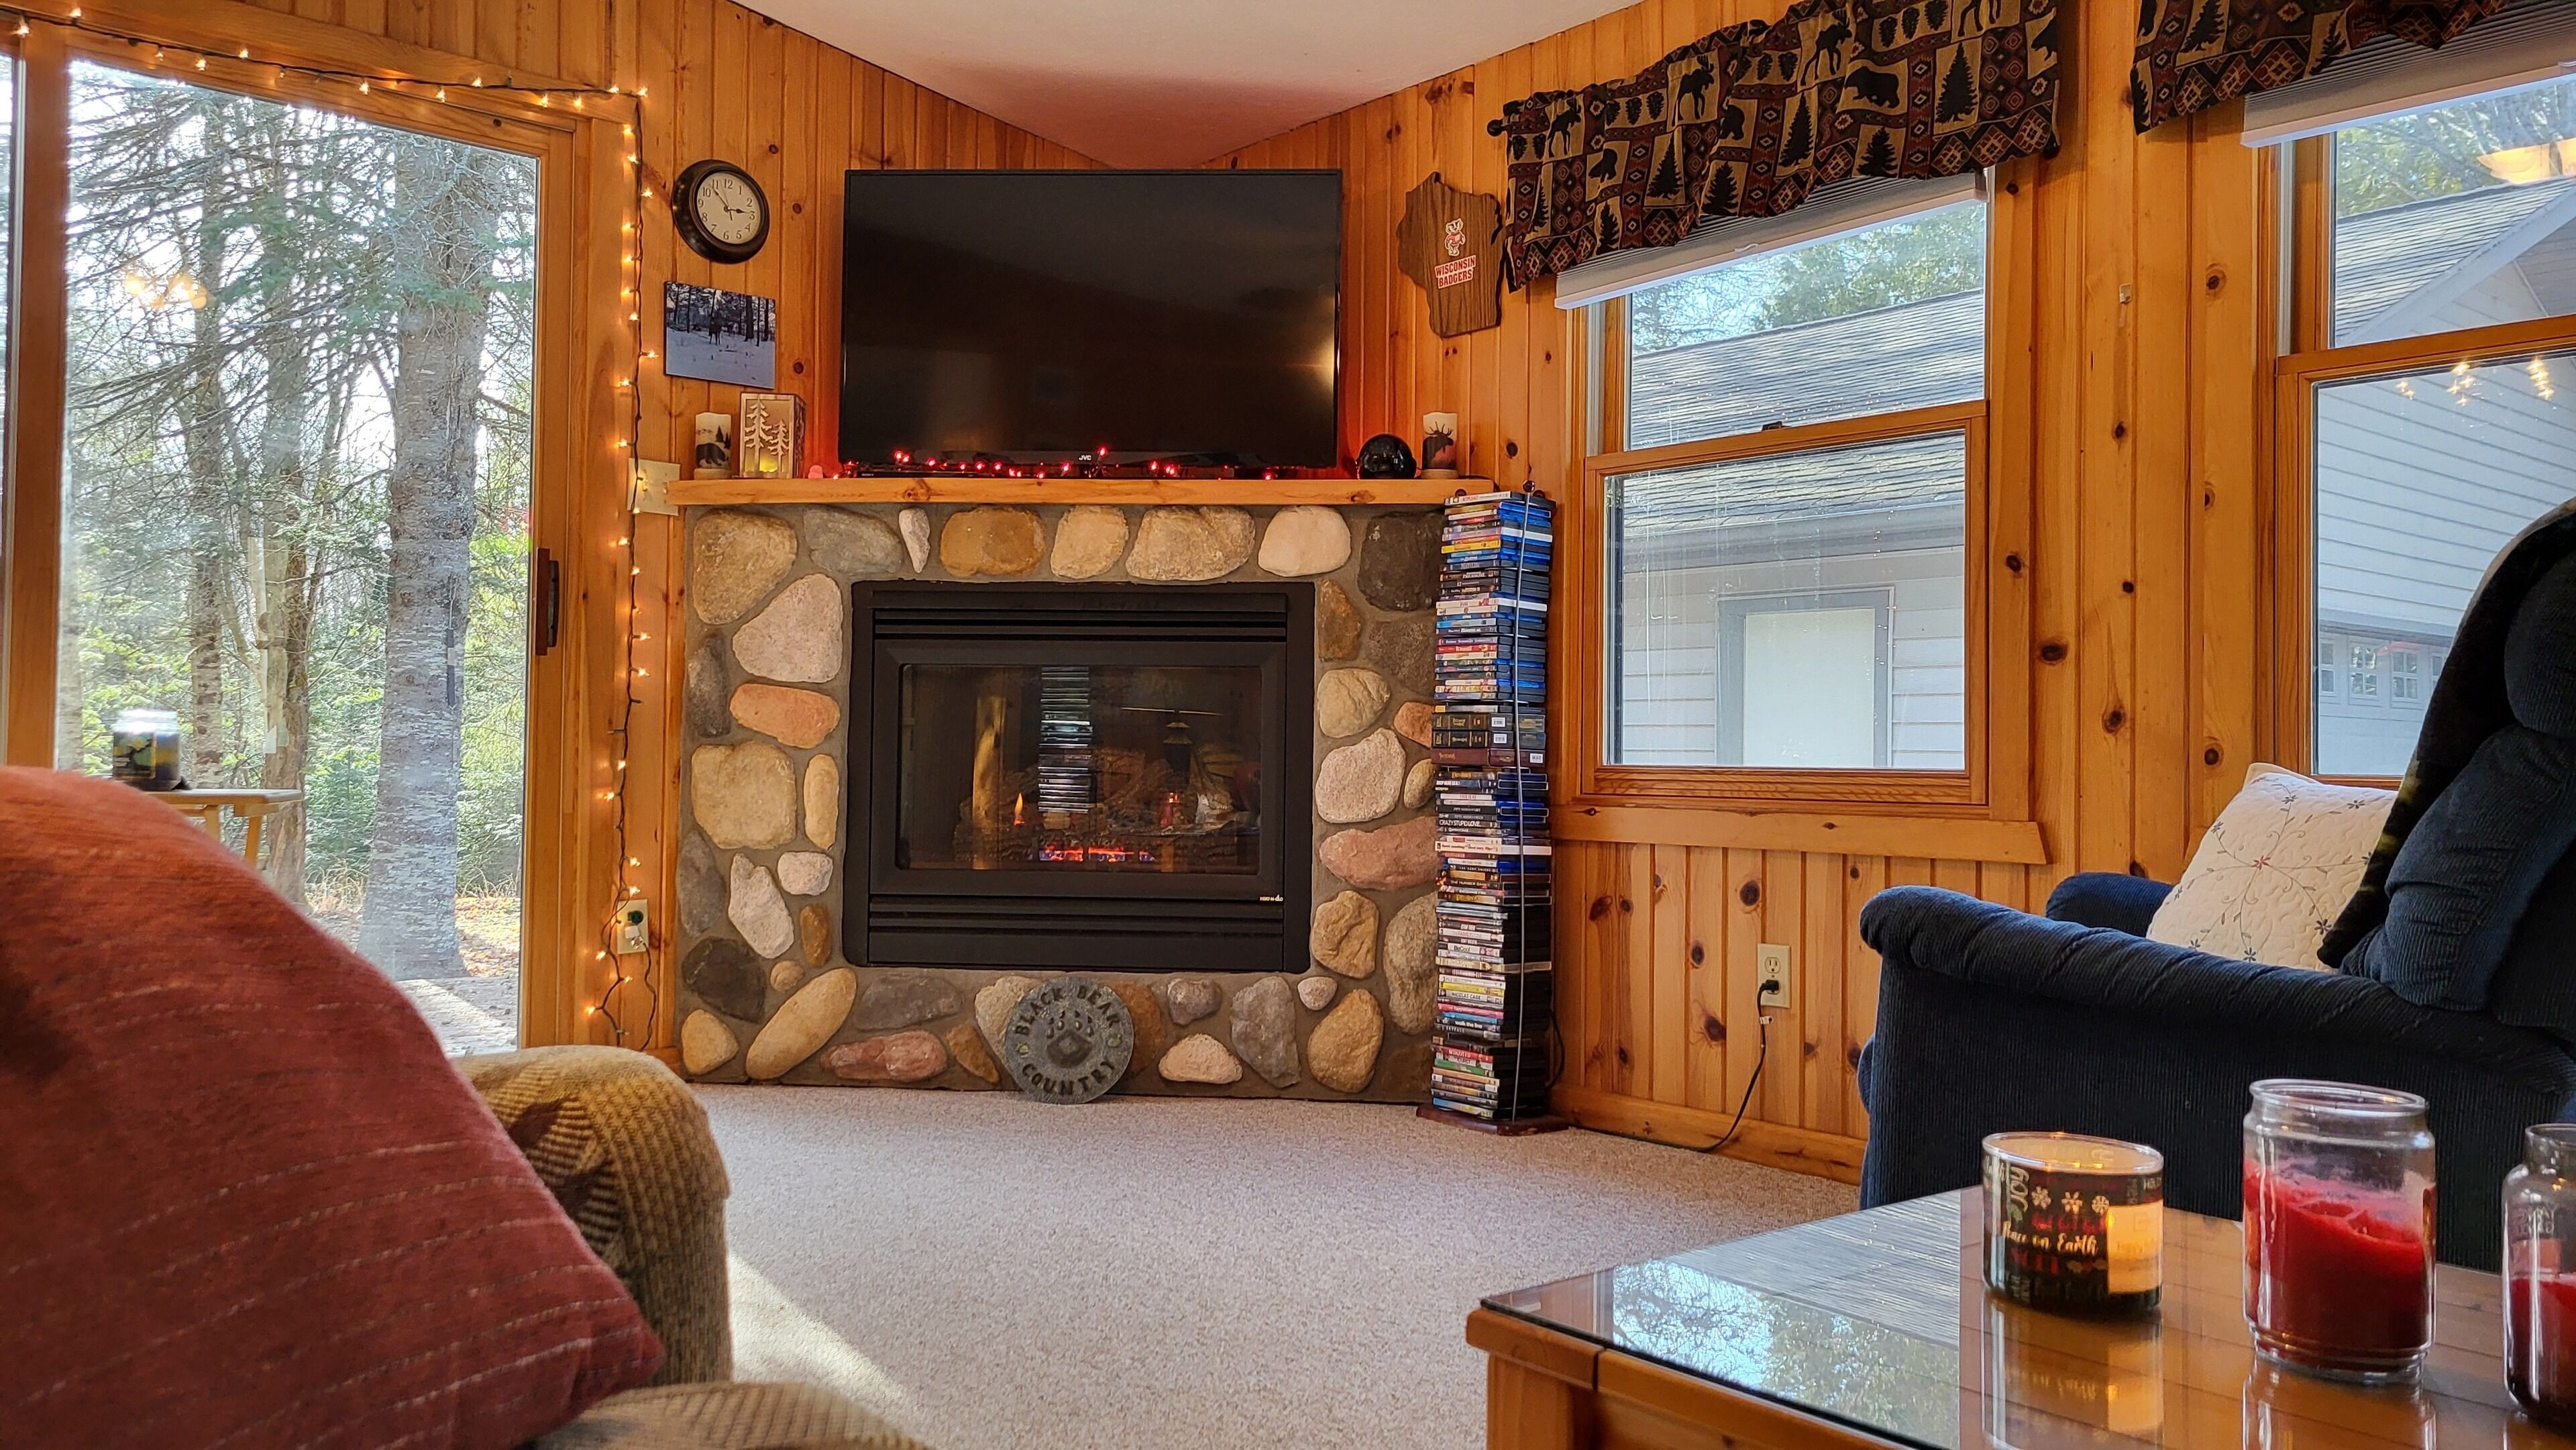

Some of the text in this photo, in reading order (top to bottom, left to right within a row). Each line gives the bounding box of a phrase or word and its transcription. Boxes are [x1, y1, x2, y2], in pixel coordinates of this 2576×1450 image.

[712, 178, 718, 189] 11
[724, 178, 733, 189] 12
[702, 187, 711, 197] 10
[739, 185, 742, 195] 1
[698, 199, 704, 208] 9
[747, 198, 753, 207] 2
[702, 212, 708, 222] 8
[749, 211, 755, 220] 3
[711, 224, 717, 232] 7
[745, 223, 751, 232] 4
[723, 231, 729, 240] 6
[736, 230, 742, 240] 5
[1436, 256, 1476, 276] WISCONSIN
[1439, 269, 1472, 287] BADGERS
[1015, 985, 1120, 1036] BLACK BEAR
[1022, 1059, 1115, 1095] COUNTRY
[2057, 1233, 2097, 1256] Earth
